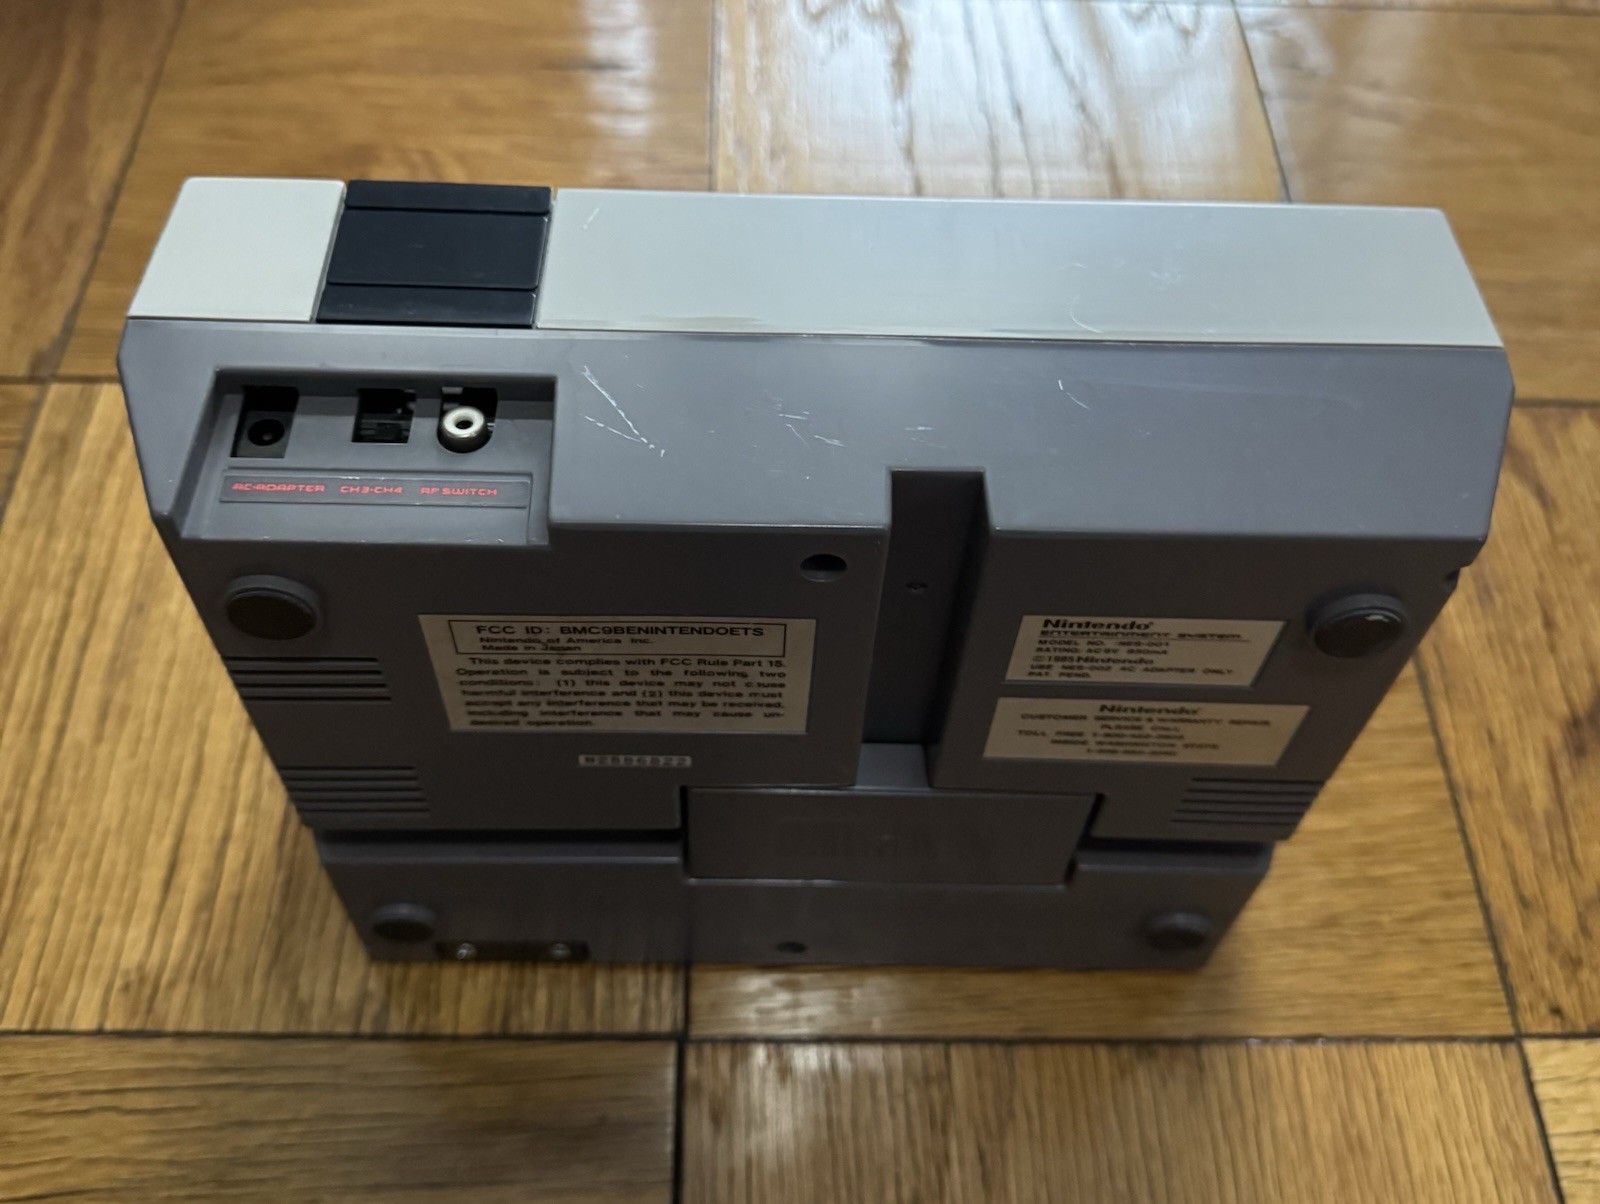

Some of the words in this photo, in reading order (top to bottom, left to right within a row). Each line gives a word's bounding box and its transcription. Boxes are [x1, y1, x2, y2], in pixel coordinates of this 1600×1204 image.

[232, 482, 326, 493] AC-ADAPTER
[419, 486, 439, 495] RF
[441, 487, 498, 496] SWITCH
[476, 625, 516, 635] FCC
[560, 625, 764, 636] BMC9BENINTENDOETS
[541, 643, 582, 652] Japan
[469, 657, 500, 666] This
[504, 658, 552, 666] device
[556, 658, 621, 668] complies
[625, 658, 656, 667] with
[660, 658, 693, 667] FCC
[696, 659, 729, 668] Rule
[733, 660, 762, 668] Part
[456, 668, 528, 677] Operation
[538, 668, 550, 676] is
[561, 668, 614, 677] subject
[624, 669, 640, 677] to
[650, 669, 673, 677] the
[684, 669, 749, 679] following
[759, 671, 787, 679] two
[556, 679, 576, 688] (1)
[585, 679, 611, 687] this
[674, 681, 704, 689] may
[612, 690, 638, 698] and
[642, 690, 663, 699] (2)
[669, 690, 694, 698] this
[698, 690, 744, 699] device
[748, 691, 783, 699] must
[546, 700, 631, 708] interference
[636, 700, 663, 708] that
[668, 701, 697, 709] may
[540, 710, 624, 718] interference
[634, 709, 662, 718] that
[673, 710, 702, 719] may
[713, 710, 753, 718] cause
